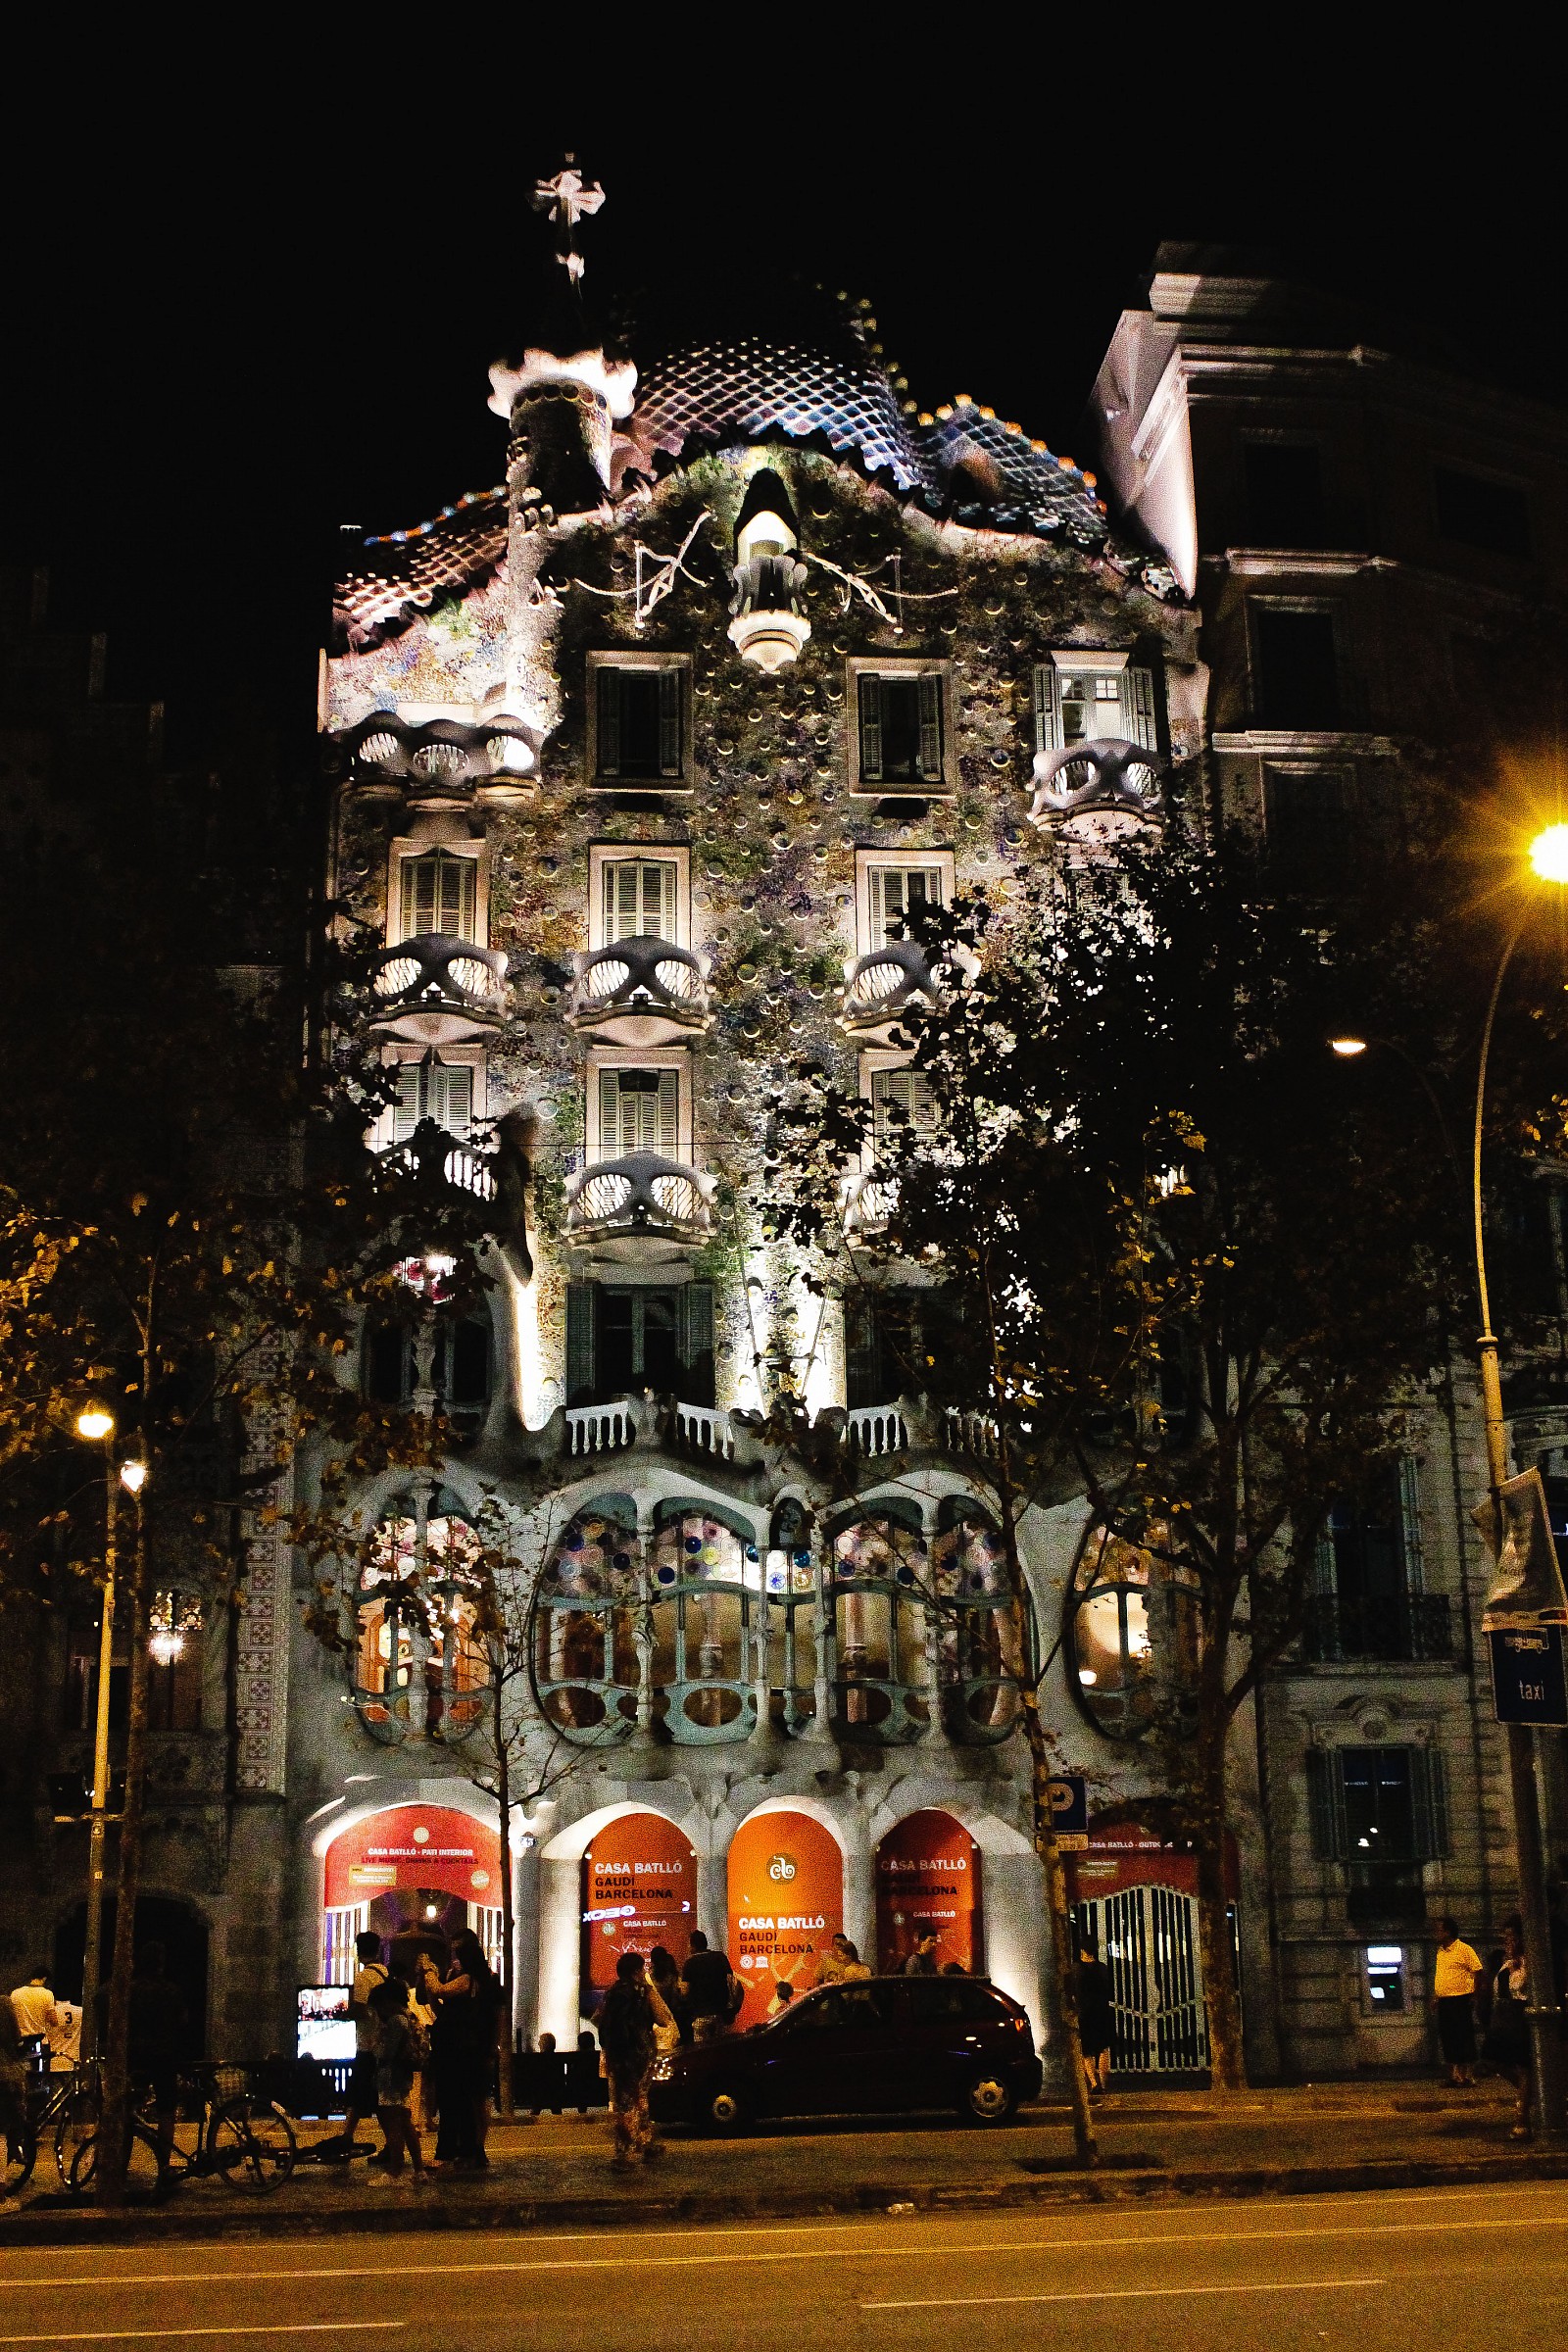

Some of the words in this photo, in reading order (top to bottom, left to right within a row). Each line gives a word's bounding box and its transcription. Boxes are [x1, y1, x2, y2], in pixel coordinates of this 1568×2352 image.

[1519, 1680, 1544, 1700] taxi
[368, 1847, 388, 1856] CASA
[438, 1848, 473, 1857] INTERIOR
[594, 1862, 631, 1875] CASA
[634, 1860, 683, 1874] BATLLÓ
[881, 1859, 916, 1871] CASA
[919, 1857, 967, 1871] BATLLÓ
[595, 1888, 673, 1900] BARCELONA
[738, 1916, 775, 1929] CASA
[777, 1915, 825, 1930] BATLLÓ
[739, 1930, 777, 1941] GAUDÍ
[740, 1944, 814, 1954] BARCELONA
